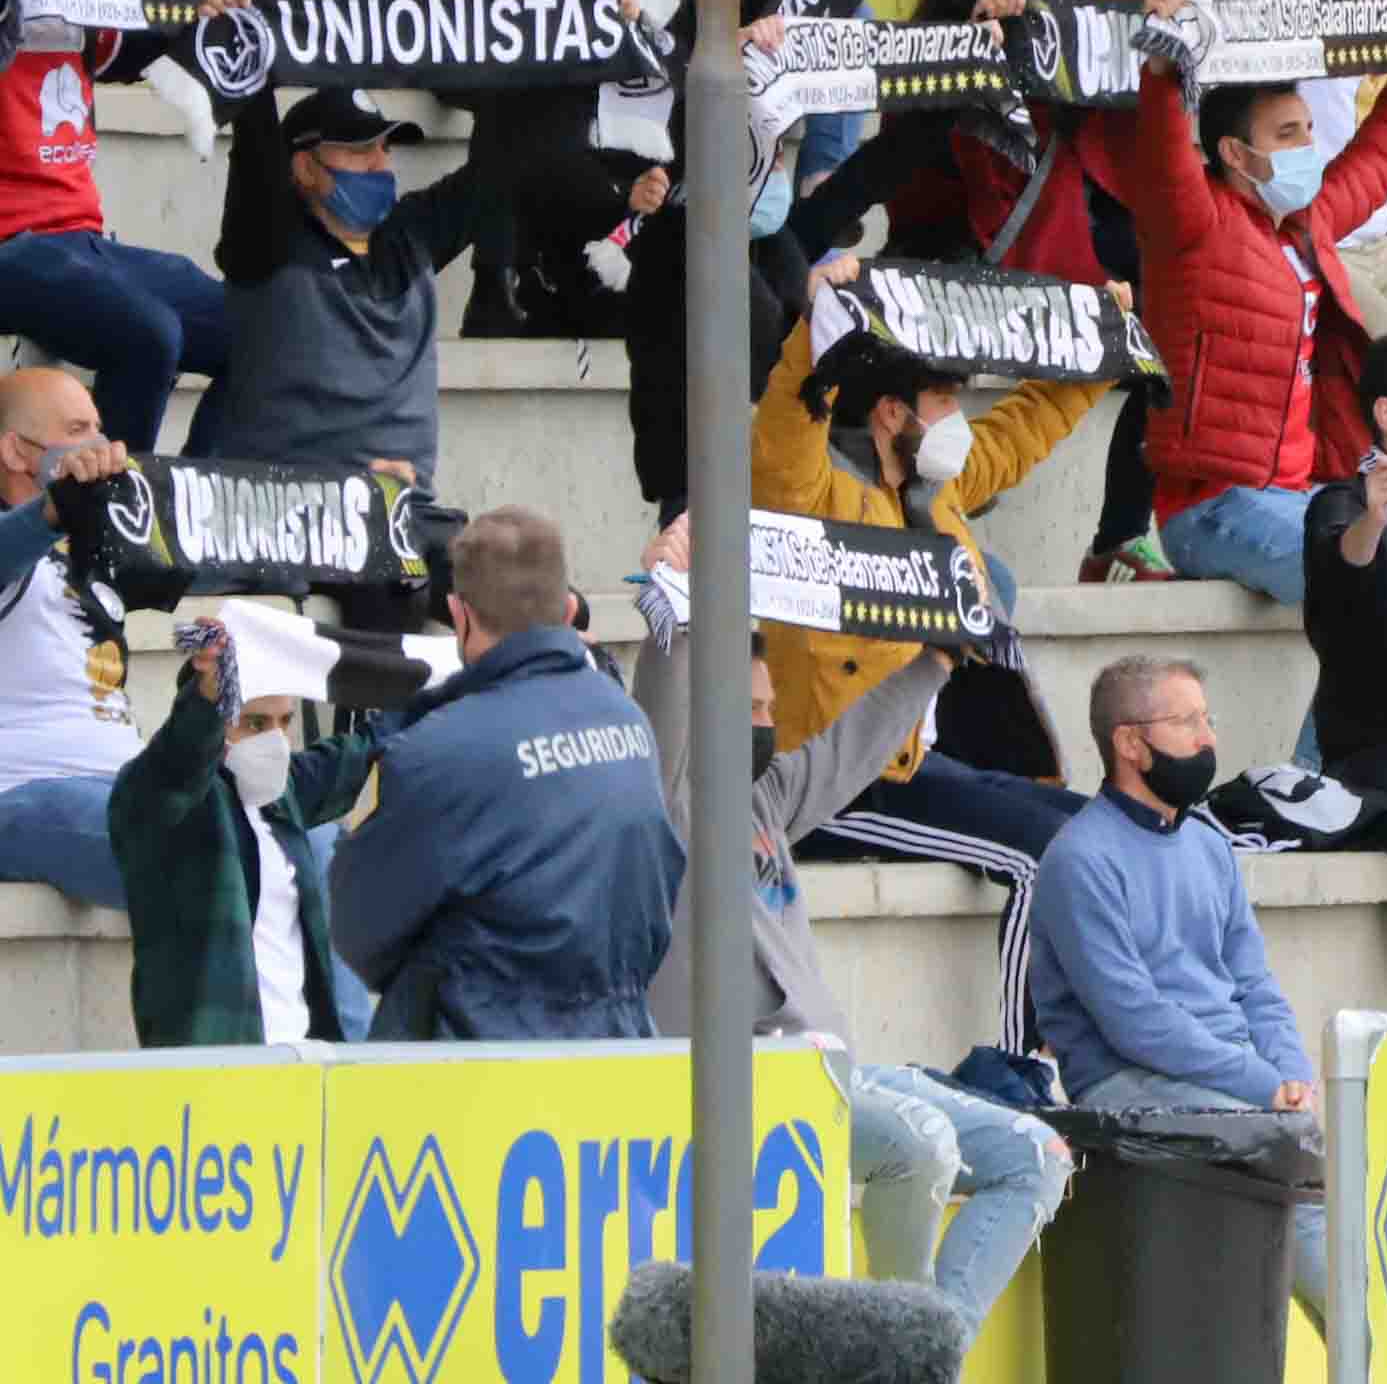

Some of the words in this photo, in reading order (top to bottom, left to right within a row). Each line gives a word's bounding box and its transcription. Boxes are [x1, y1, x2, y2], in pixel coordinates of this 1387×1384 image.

[865, 21, 972, 70] Salamanca
[870, 268, 1105, 373] UNIONISTAS
[172, 467, 370, 573] UNIONISTAS
[517, 725, 649, 779] SEGURIDAD
[0, 1103, 254, 1238] Mármoles
[270, 1140, 305, 1263] y
[72, 1300, 300, 1384] Granitos
